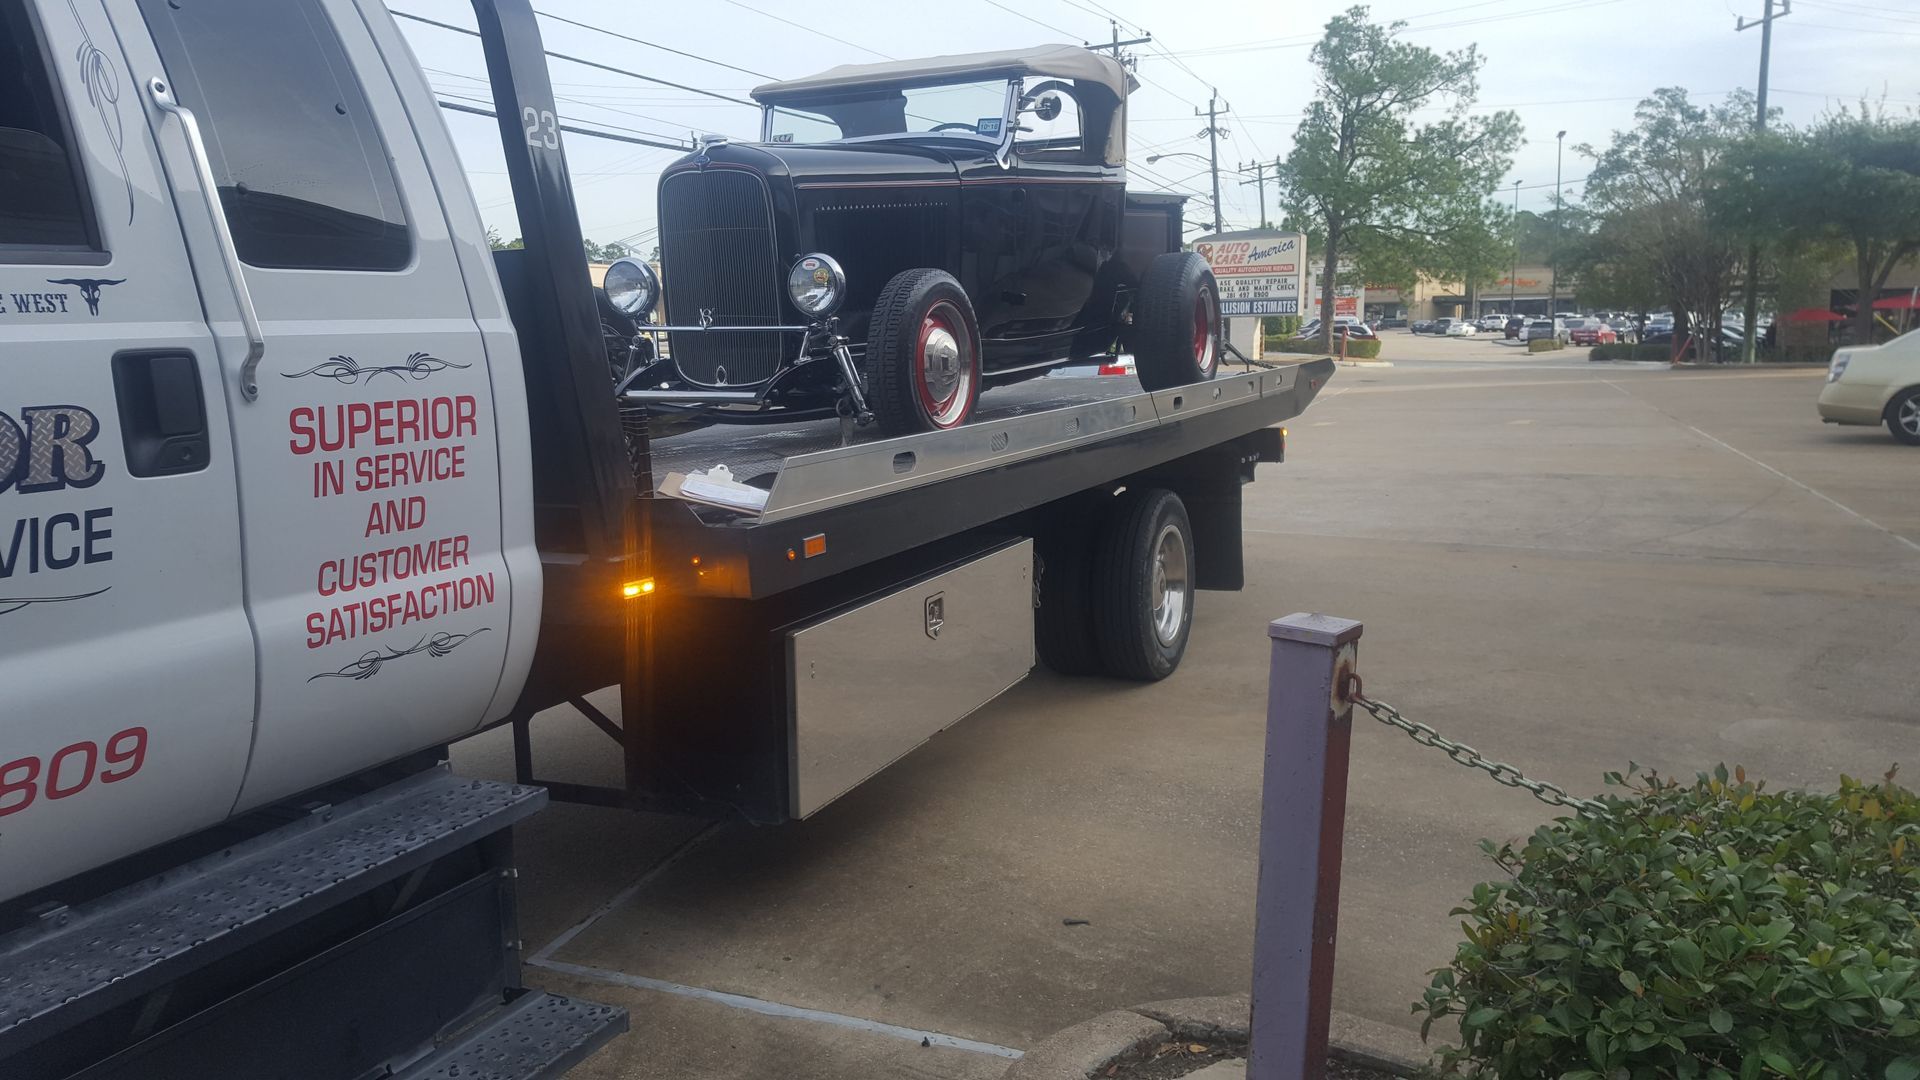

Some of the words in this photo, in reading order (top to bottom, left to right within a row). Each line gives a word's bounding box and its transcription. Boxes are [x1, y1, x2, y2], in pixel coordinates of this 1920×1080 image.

[523, 106, 559, 150] 23
[1215, 253, 1246, 265] CARE
[1216, 242, 1250, 254] AUTO
[1247, 240, 1295, 264] America
[1214, 266, 1237, 274] QUALITY
[1237, 265, 1272, 273] AUTOMOTIVE
[1272, 264, 1293, 272] REPAIR
[10, 293, 68, 313] WEST
[1276, 283, 1296, 291] CHECK
[1220, 302, 1250, 314] LLISION
[1253, 300, 1297, 314] ESTIMATES
[289, 395, 477, 455] SUPERIOR
[314, 459, 344, 498] IN
[355, 445, 465, 492] SERVICE
[365, 496, 426, 538] AND
[317, 535, 469, 597] CUSTOMER
[306, 572, 495, 649] SATISFACTION
[0, 727, 148, 817] 809
